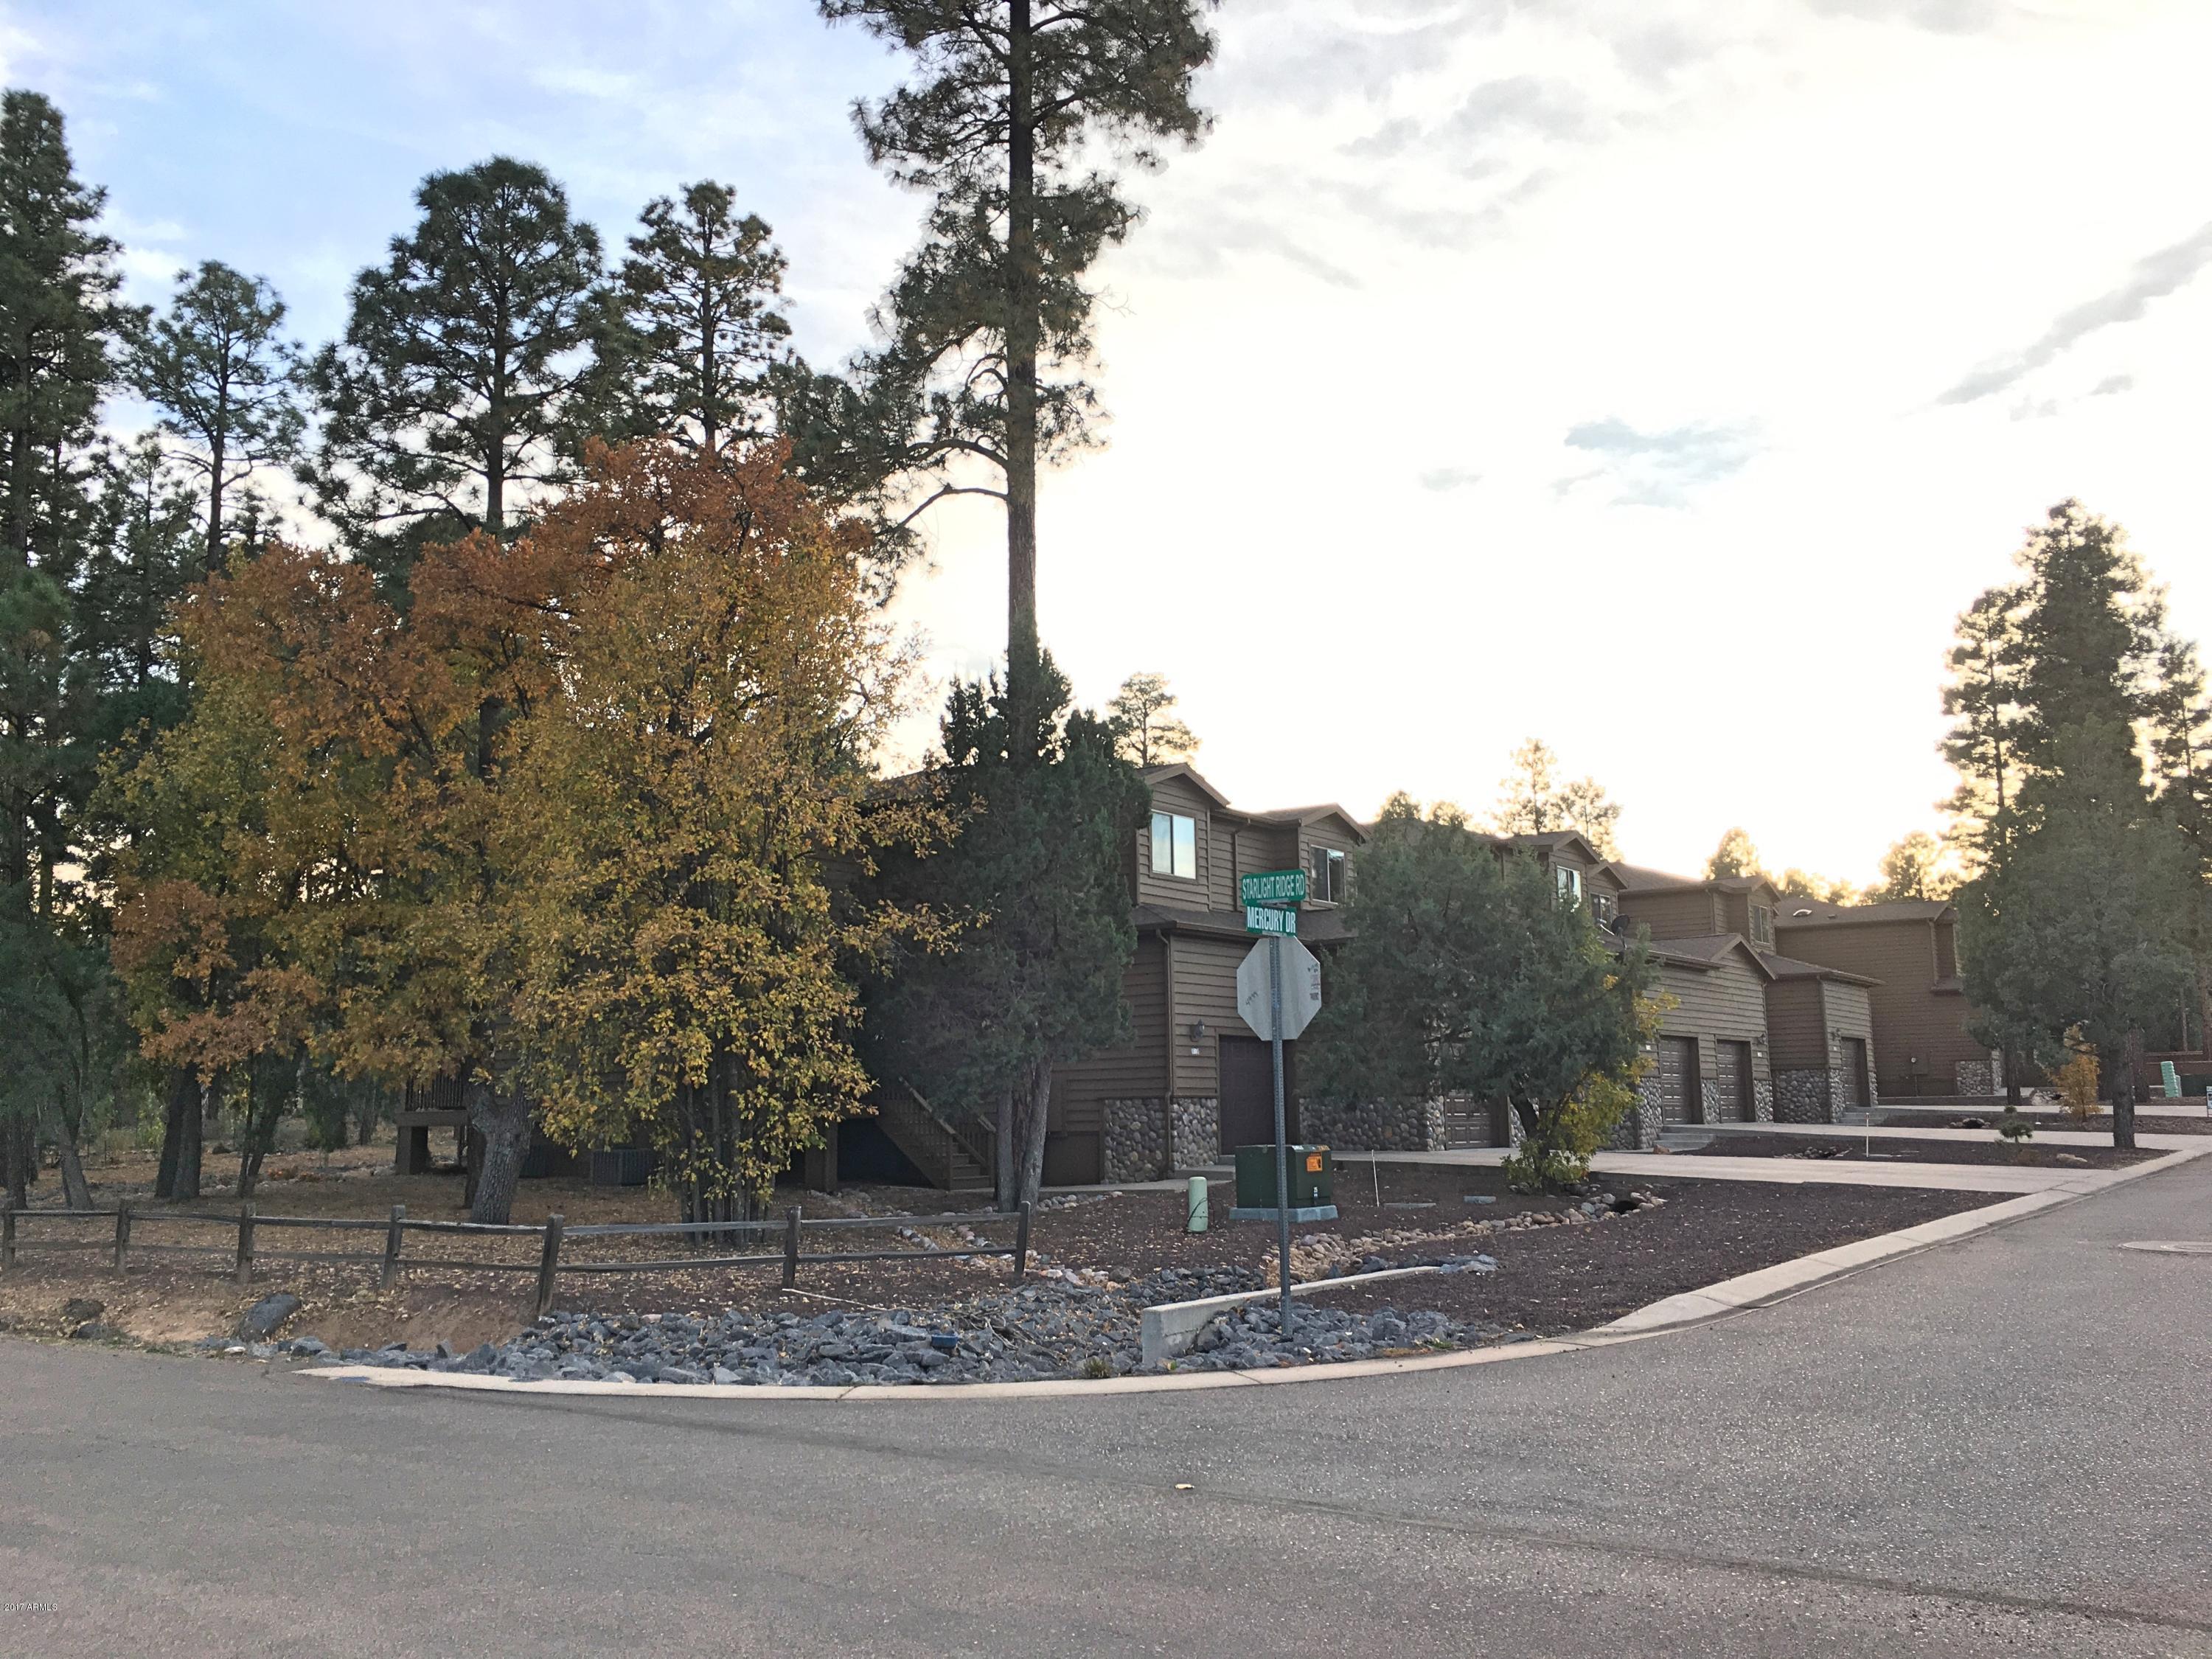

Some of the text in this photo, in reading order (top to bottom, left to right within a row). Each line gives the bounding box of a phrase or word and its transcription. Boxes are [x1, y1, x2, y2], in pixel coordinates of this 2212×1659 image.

[1242, 874, 1305, 900] STARLIGHT RIDGE RD
[1247, 906, 1296, 933] MERCURY DR
